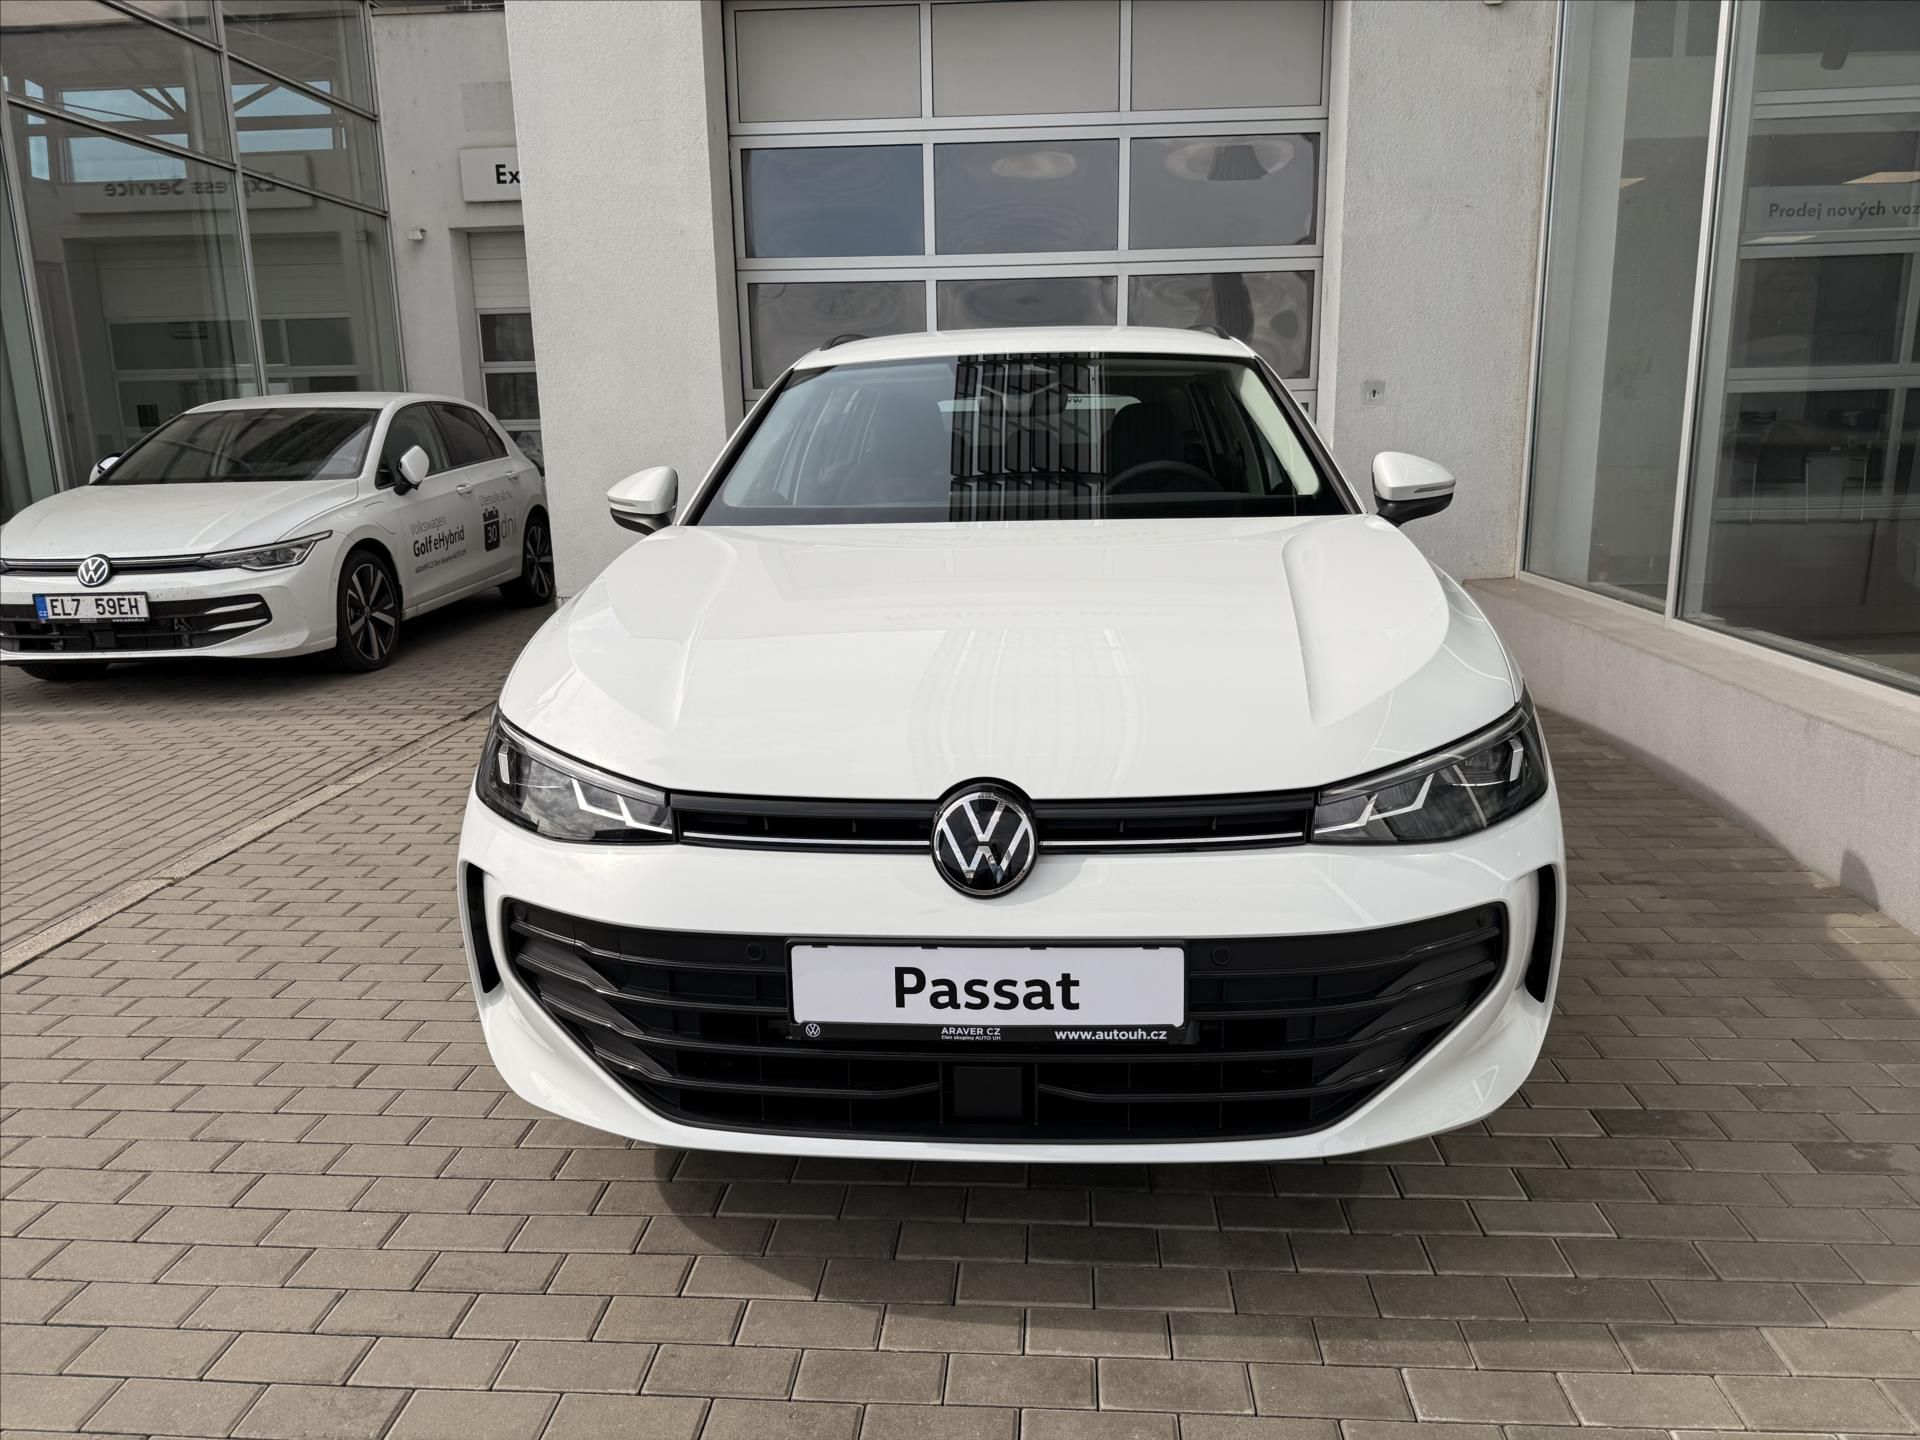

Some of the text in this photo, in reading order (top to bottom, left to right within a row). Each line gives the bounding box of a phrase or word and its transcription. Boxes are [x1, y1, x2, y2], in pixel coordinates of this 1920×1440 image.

[495, 164, 520, 184] Ex
[1769, 200, 1920, 220] Prodej nových voz
[413, 524, 465, 557] Golf eHybrid
[487, 524, 498, 543] 30
[50, 597, 140, 617] EL7 59EH
[895, 966, 1080, 1010] Passat
[941, 1027, 1001, 1036] ARAVER CZ
[1054, 1028, 1168, 1041] www.autouh.cz
